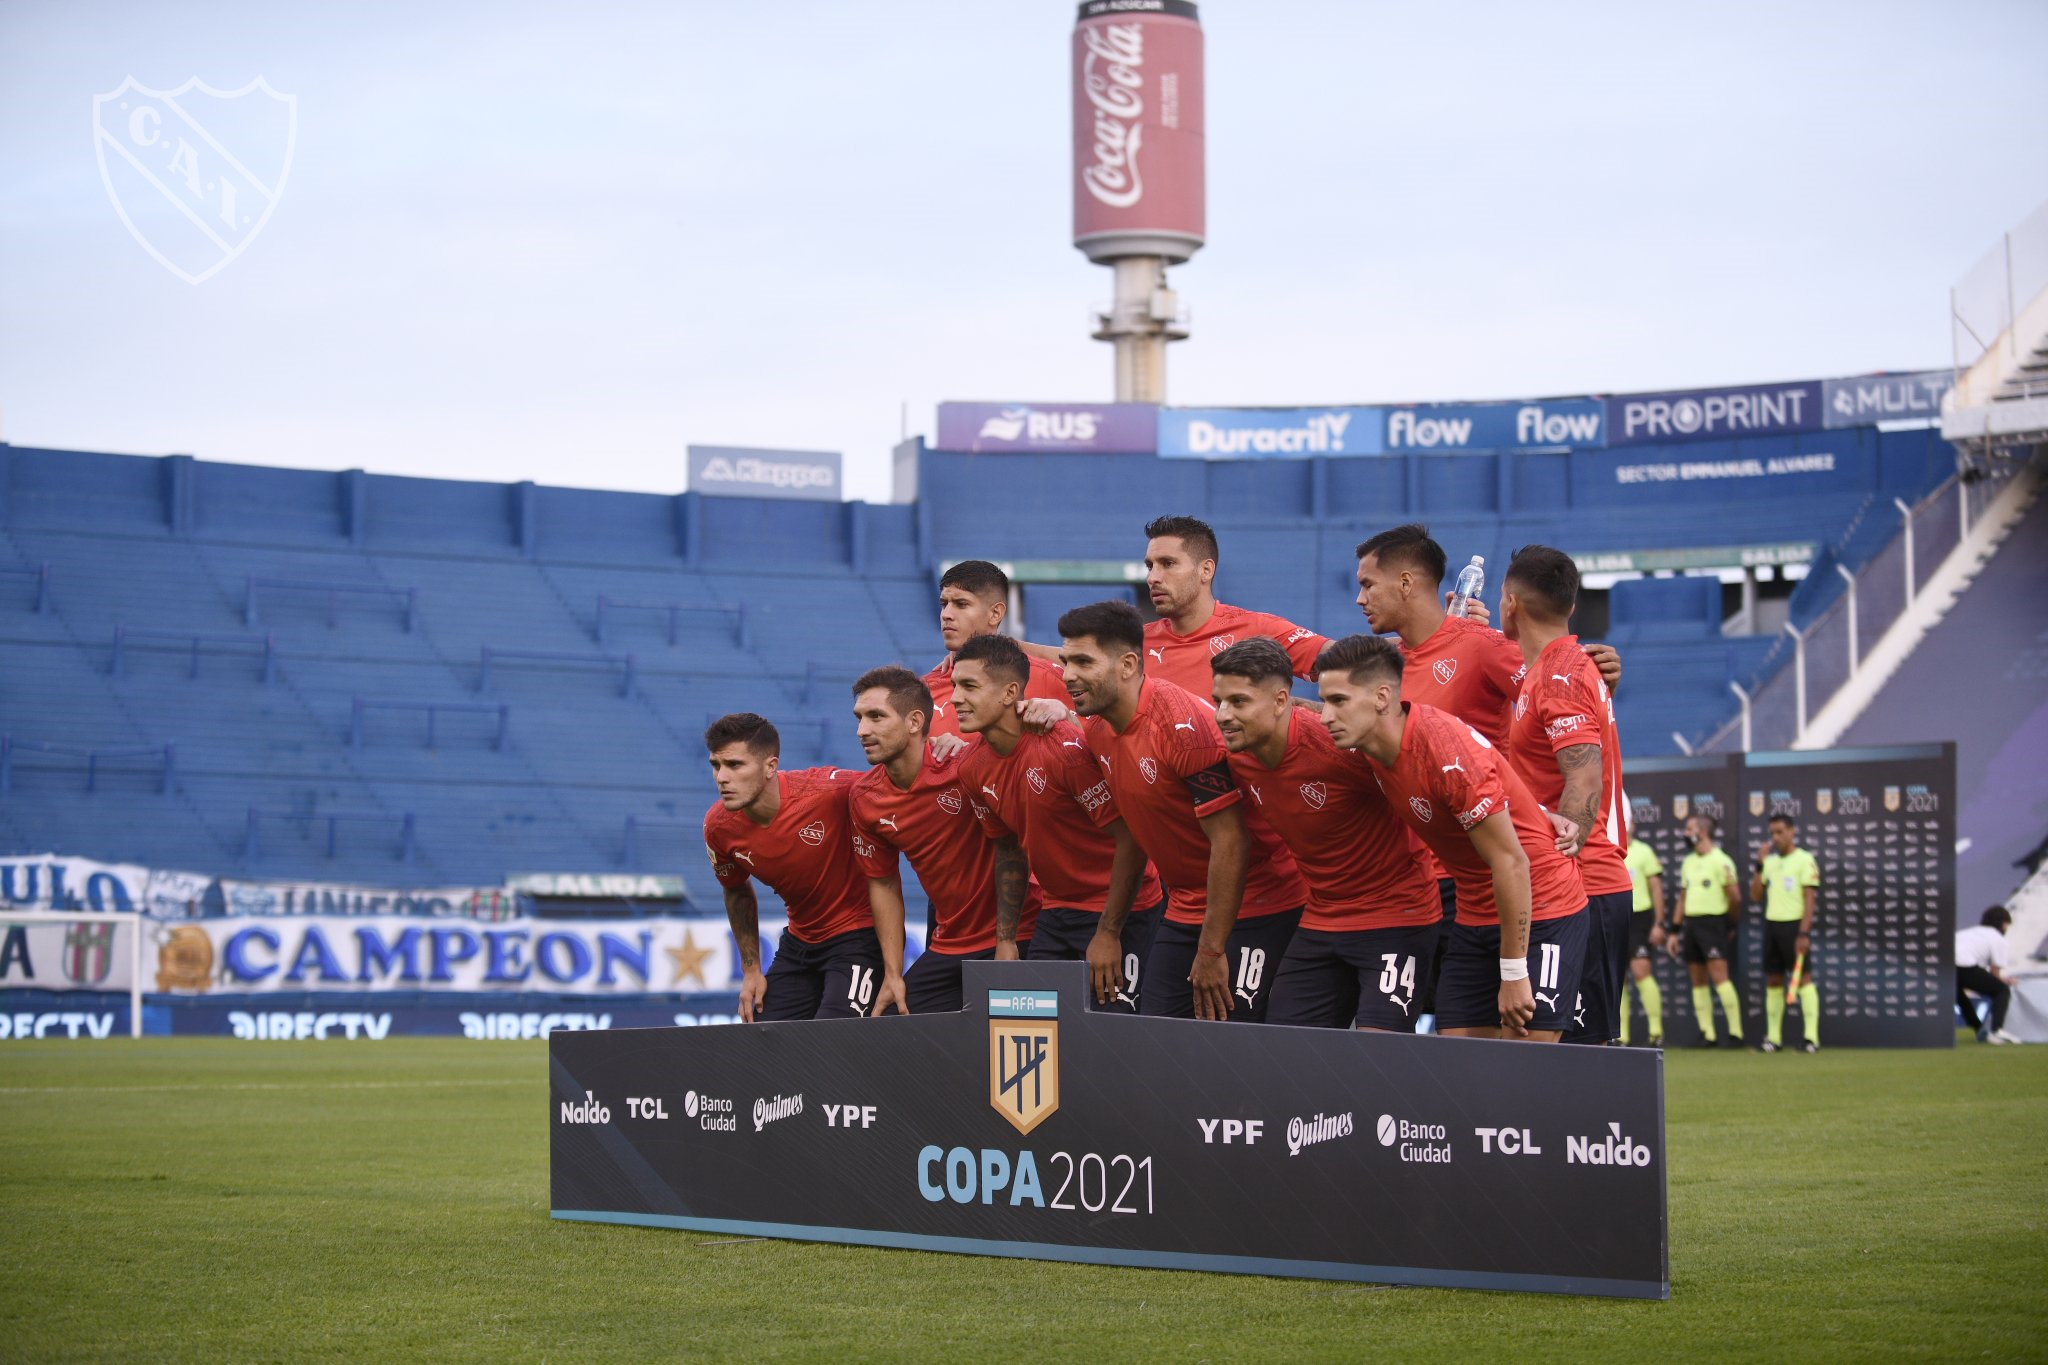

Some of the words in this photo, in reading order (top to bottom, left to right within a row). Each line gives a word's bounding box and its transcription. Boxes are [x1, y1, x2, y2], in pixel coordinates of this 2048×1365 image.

[1625, 389, 1807, 436] PROPRINT
[1857, 384, 1944, 415] MULT
[1028, 413, 1097, 440] RUS
[1389, 412, 1472, 447] flow
[1517, 406, 1600, 444] flow
[734, 458, 834, 489] Kappa
[1616, 463, 1678, 484] SECTOR
[1680, 458, 1764, 480] EMMANUEL
[1575, 554, 1633, 572] ALIDA
[1837, 796, 1869, 815] 2021
[1906, 793, 1938, 812] 2021
[522, 874, 663, 897] SALIDA
[223, 925, 650, 984] CAMPEON
[1236, 946, 1266, 990] 18
[1540, 943, 1560, 989] 11
[848, 964, 874, 1005] 16
[1379, 953, 1416, 998] 34
[1012, 996, 1034, 1011] AFA
[228, 1012, 392, 1040] DIRECTV
[561, 1091, 610, 1125] Naldo
[626, 1097, 668, 1120] TCL
[700, 1095, 732, 1112] Banco
[753, 1093, 803, 1133] Quilmes
[822, 1104, 877, 1129] YPF
[700, 1114, 736, 1131] Ciudad
[1197, 1118, 1264, 1145] YPF
[1286, 1111, 1353, 1157] Quilmes
[1400, 1119, 1446, 1140] Banco
[1400, 1142, 1452, 1164] Ciudad
[1475, 1127, 1541, 1155] TCL
[1566, 1122, 1651, 1168] Naldo
[917, 1144, 1046, 1208] COPA
[1050, 1151, 1153, 1214] 2021
